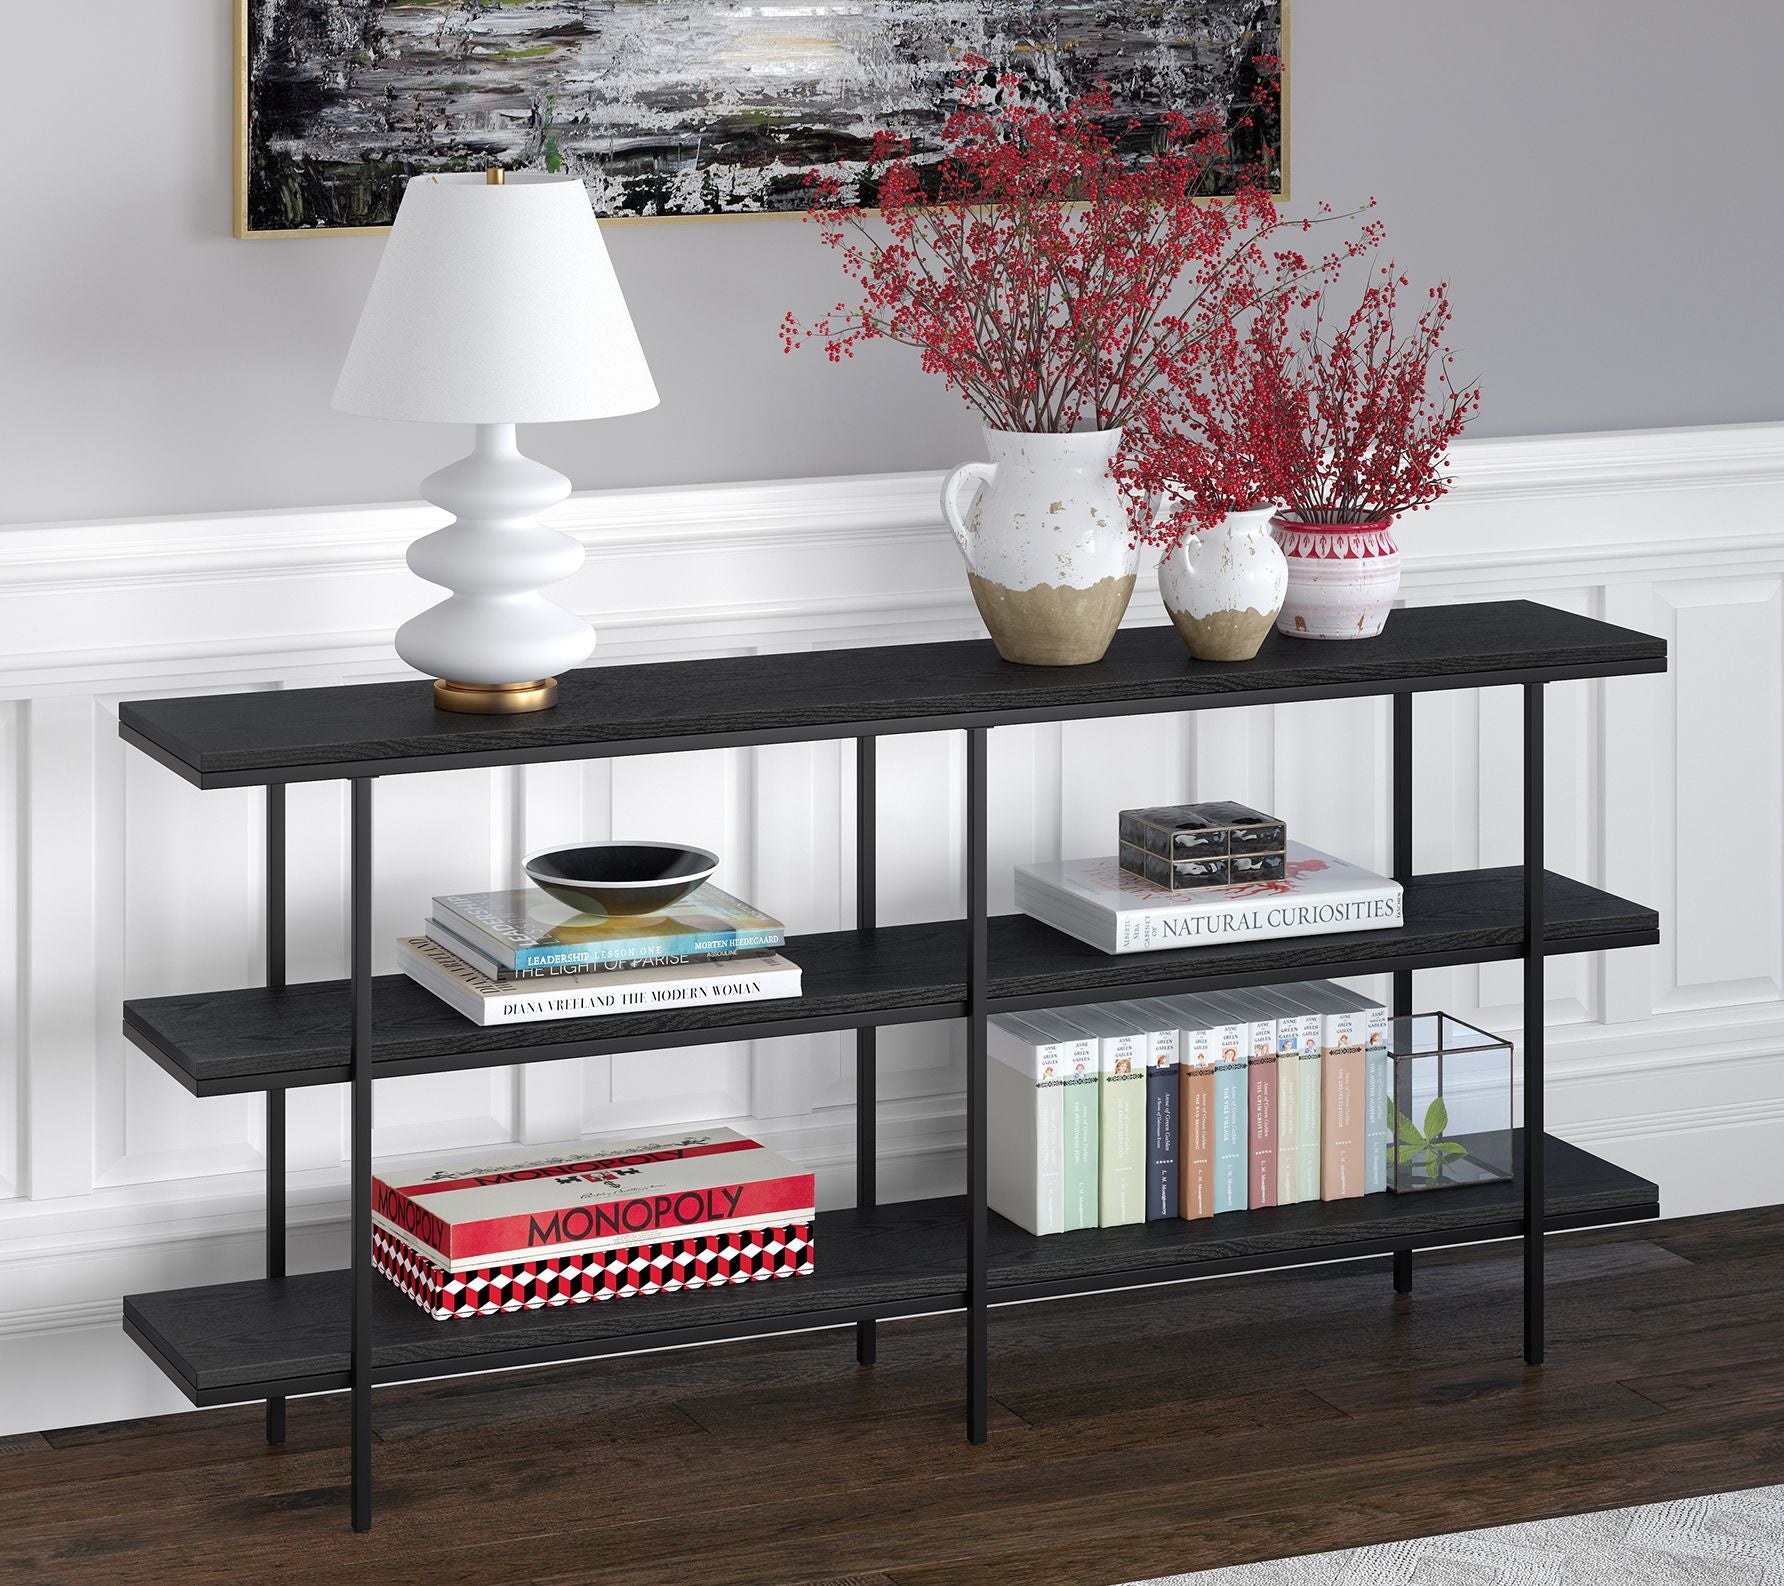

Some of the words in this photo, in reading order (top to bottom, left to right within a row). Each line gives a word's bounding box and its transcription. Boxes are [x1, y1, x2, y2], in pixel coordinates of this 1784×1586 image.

[446, 895, 539, 947] LEADERSHIP
[1162, 911, 1263, 938] NATURAL
[1267, 898, 1394, 928] CURIOSITIES
[515, 968, 545, 978] THE
[550, 962, 598, 976] LIGHT
[604, 959, 627, 971] OF
[633, 954, 690, 968] PARISE
[706, 950, 738, 958] ASSOULINE
[527, 952, 590, 966] LEADERSHIP
[594, 947, 635, 960] LESSON
[640, 945, 663, 956] ONE
[694, 940, 728, 950] MORTEN
[729, 935, 779, 947] HEEDEGAARD
[502, 1001, 543, 1016] DIANA
[548, 995, 615, 1011] VREELAND
[620, 992, 648, 1005] THE
[651, 987, 708, 1002] MODERN
[712, 981, 761, 996] WOMAN
[472, 1149, 684, 1186] MONOPOLY
[378, 1184, 444, 1250] MONOPOLY
[527, 1186, 744, 1247] MONOPOLY
